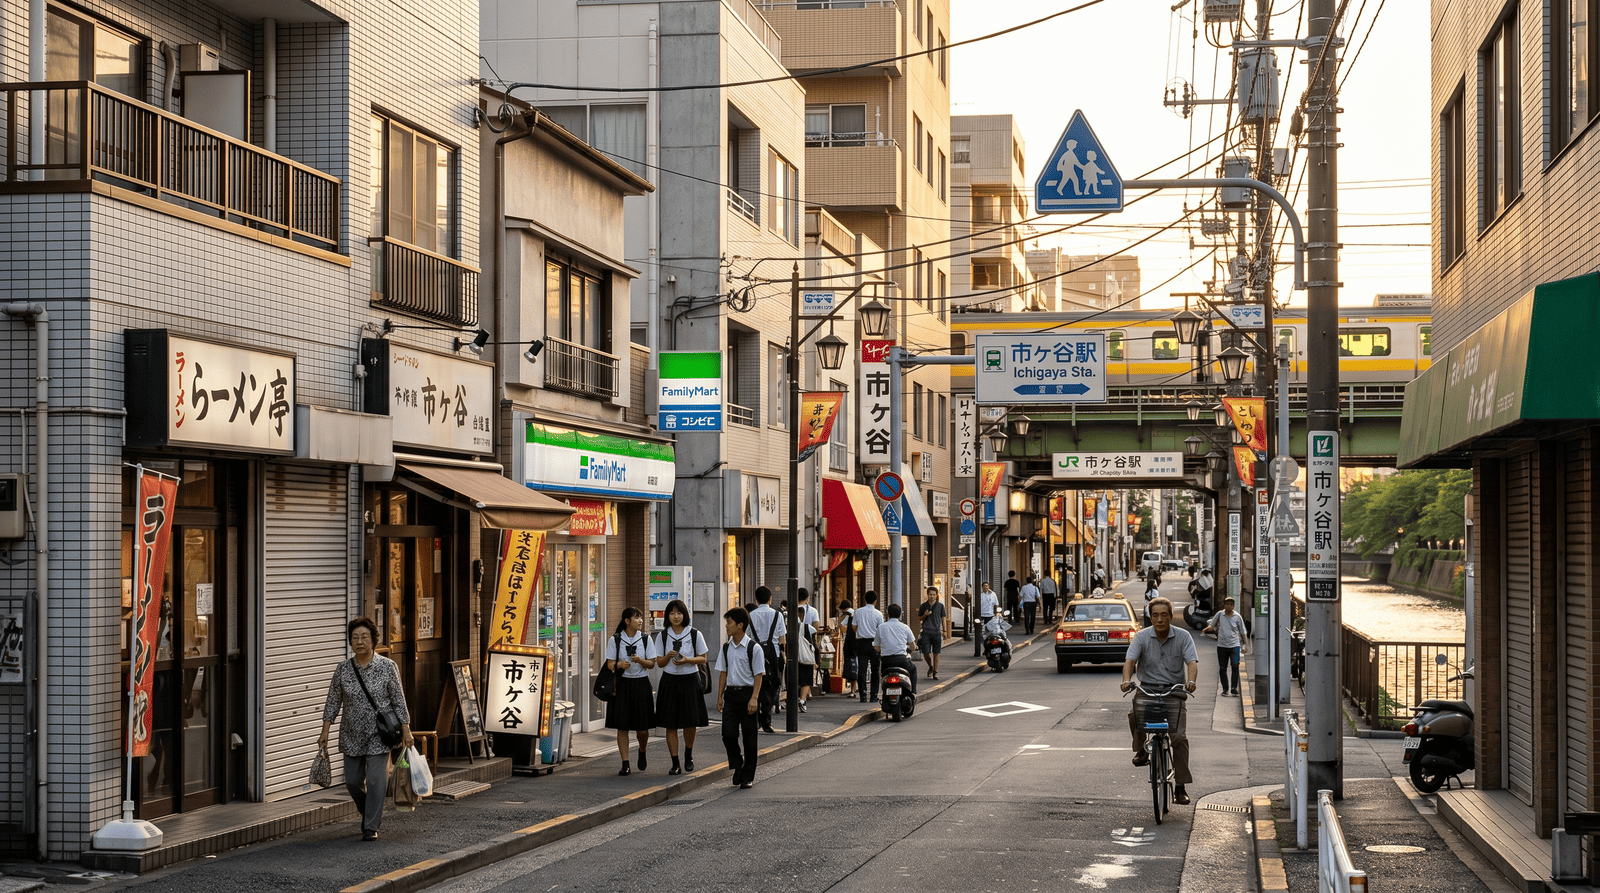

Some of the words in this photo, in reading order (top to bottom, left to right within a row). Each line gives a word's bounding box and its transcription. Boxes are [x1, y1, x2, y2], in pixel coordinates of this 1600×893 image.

[1013, 366, 1068, 380] Ichigaya
[1071, 366, 1096, 378] Sta.
[174, 350, 186, 429] ラーメン
[191, 361, 290, 437] らーメン亭
[661, 386, 719, 398] FamilyMart
[589, 457, 627, 486] FamilyMart
[1058, 456, 1080, 468] JR
[134, 494, 166, 687] ラーメン
